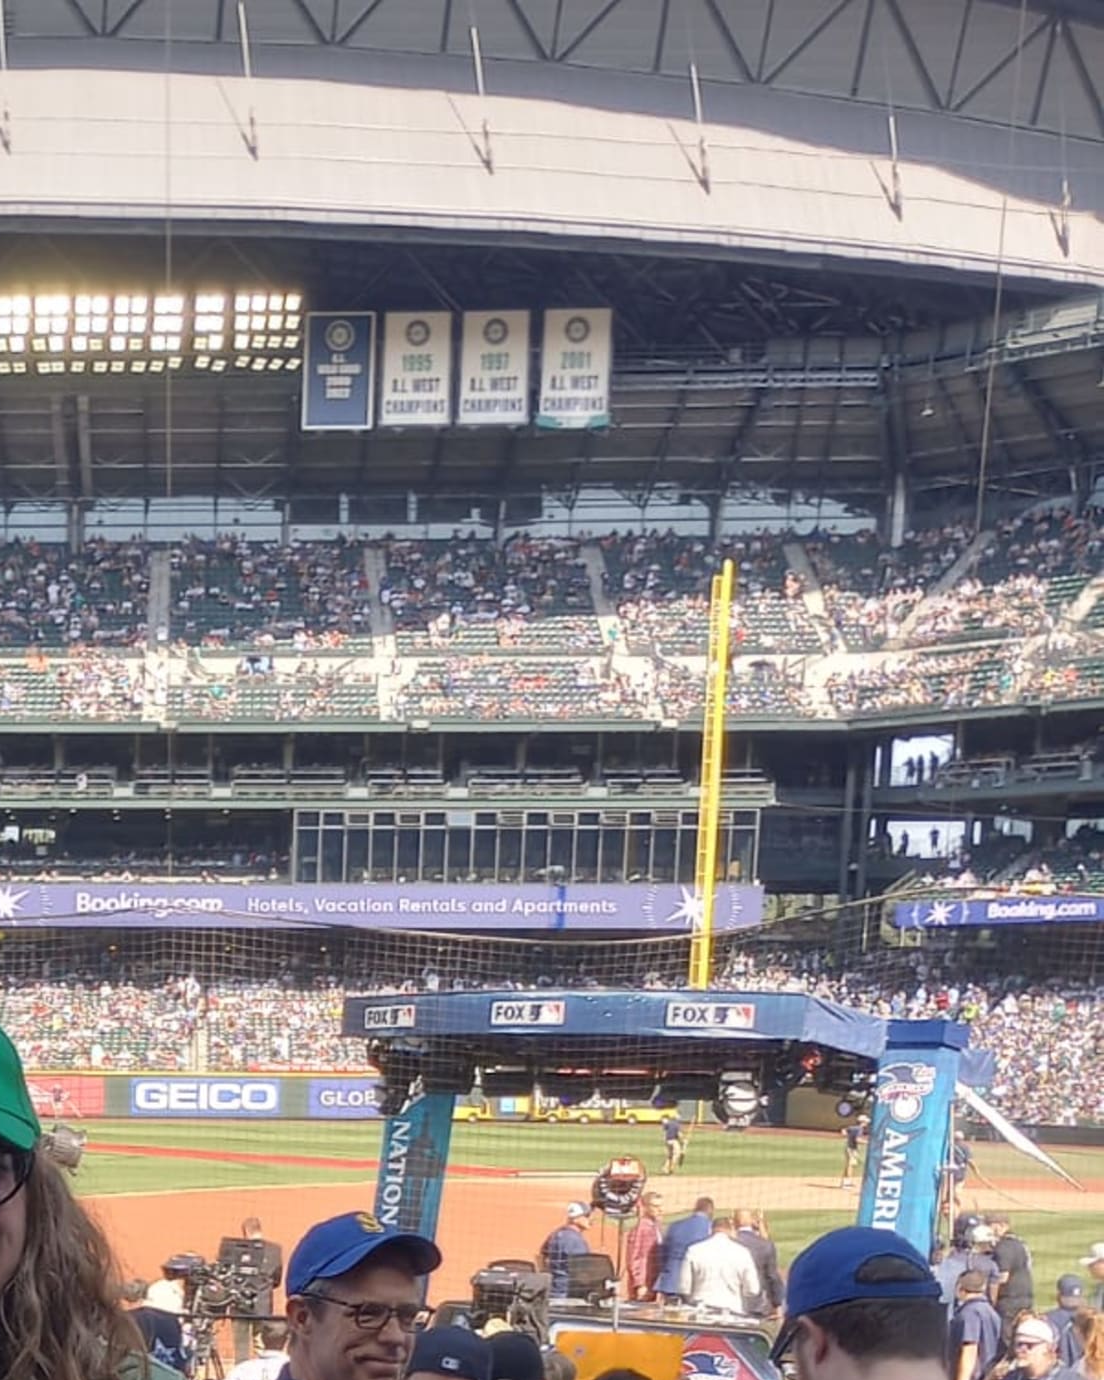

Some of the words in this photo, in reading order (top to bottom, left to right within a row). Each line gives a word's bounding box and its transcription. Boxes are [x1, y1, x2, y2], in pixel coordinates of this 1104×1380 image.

[75, 892, 223, 918] Booking.com
[247, 898, 309, 916] Hotels,
[315, 898, 393, 913] Vacation
[398, 898, 466, 913] Rentals
[471, 898, 506, 913] and
[511, 898, 617, 917] Apartments
[987, 901, 1096, 920] Booking.com
[367, 1008, 388, 1025] FOX
[496, 1004, 525, 1021] FOX
[672, 1006, 708, 1024] FOX
[135, 1082, 277, 1110] GEICO
[380, 1121, 411, 1225] NATION
